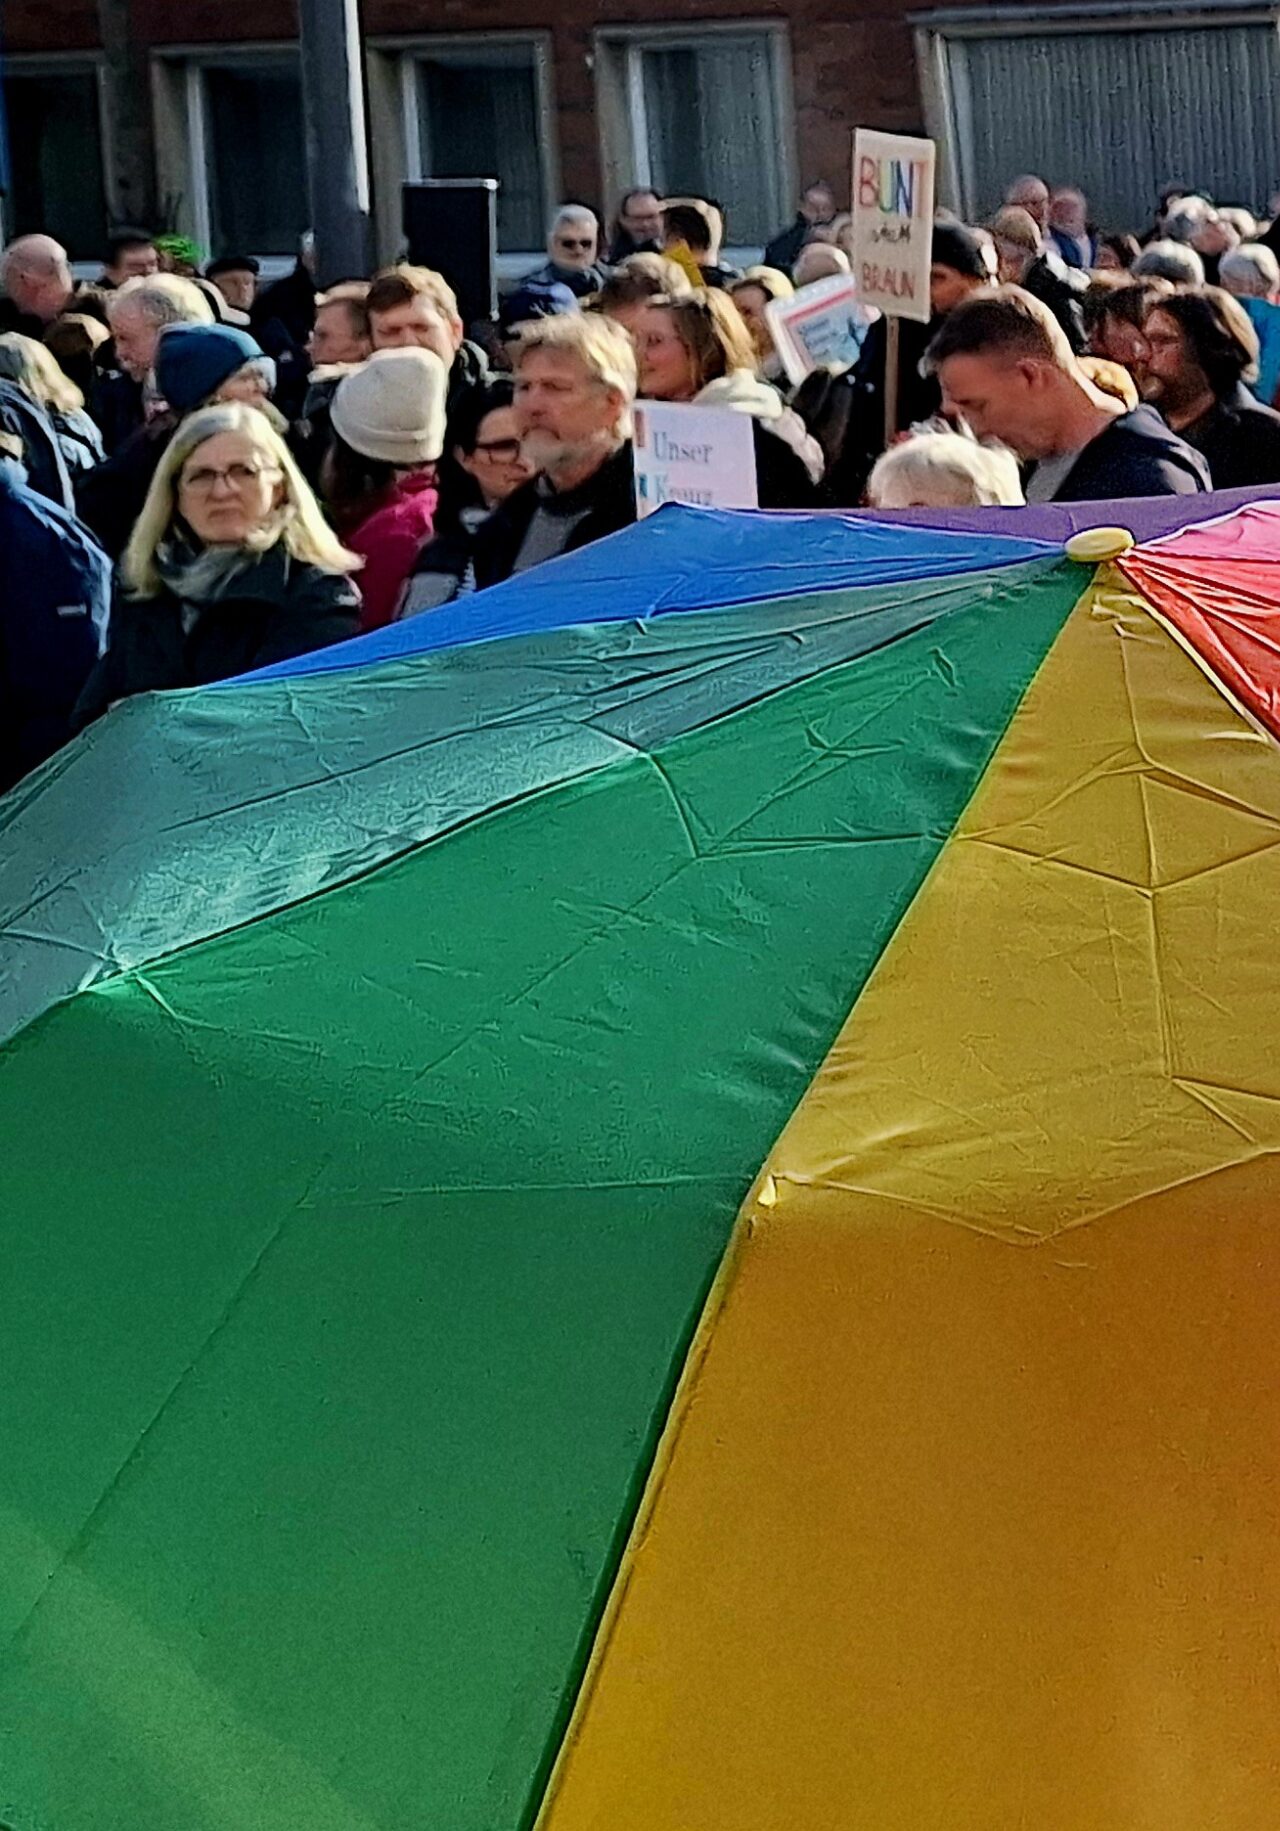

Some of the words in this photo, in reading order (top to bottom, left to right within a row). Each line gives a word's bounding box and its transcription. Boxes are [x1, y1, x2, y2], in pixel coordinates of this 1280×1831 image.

[858, 156, 930, 219] BUNT
[861, 262, 915, 300] BRAUN
[653, 431, 713, 464] Unser
